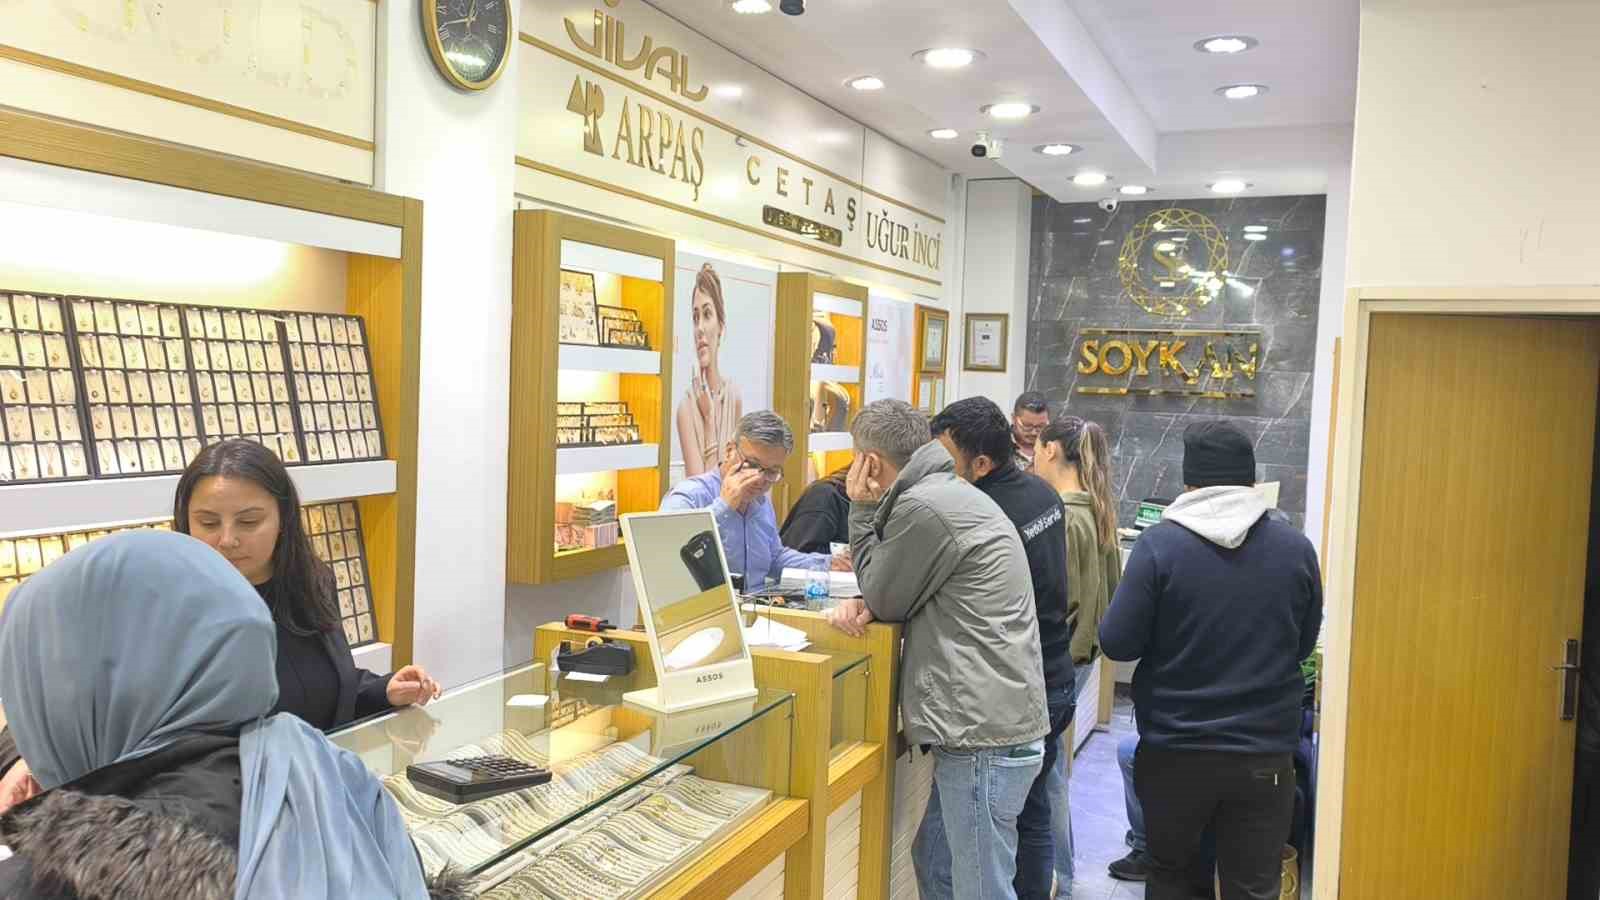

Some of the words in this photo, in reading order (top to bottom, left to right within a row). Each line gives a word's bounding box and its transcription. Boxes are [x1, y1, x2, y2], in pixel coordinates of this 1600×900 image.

[611, 95, 705, 201] ARPAŞ
[866, 209, 909, 260] UĞUR
[911, 223, 942, 270] İNCİ
[1077, 339, 1257, 384] SOYKAN
[696, 672, 723, 683] ASSOS
